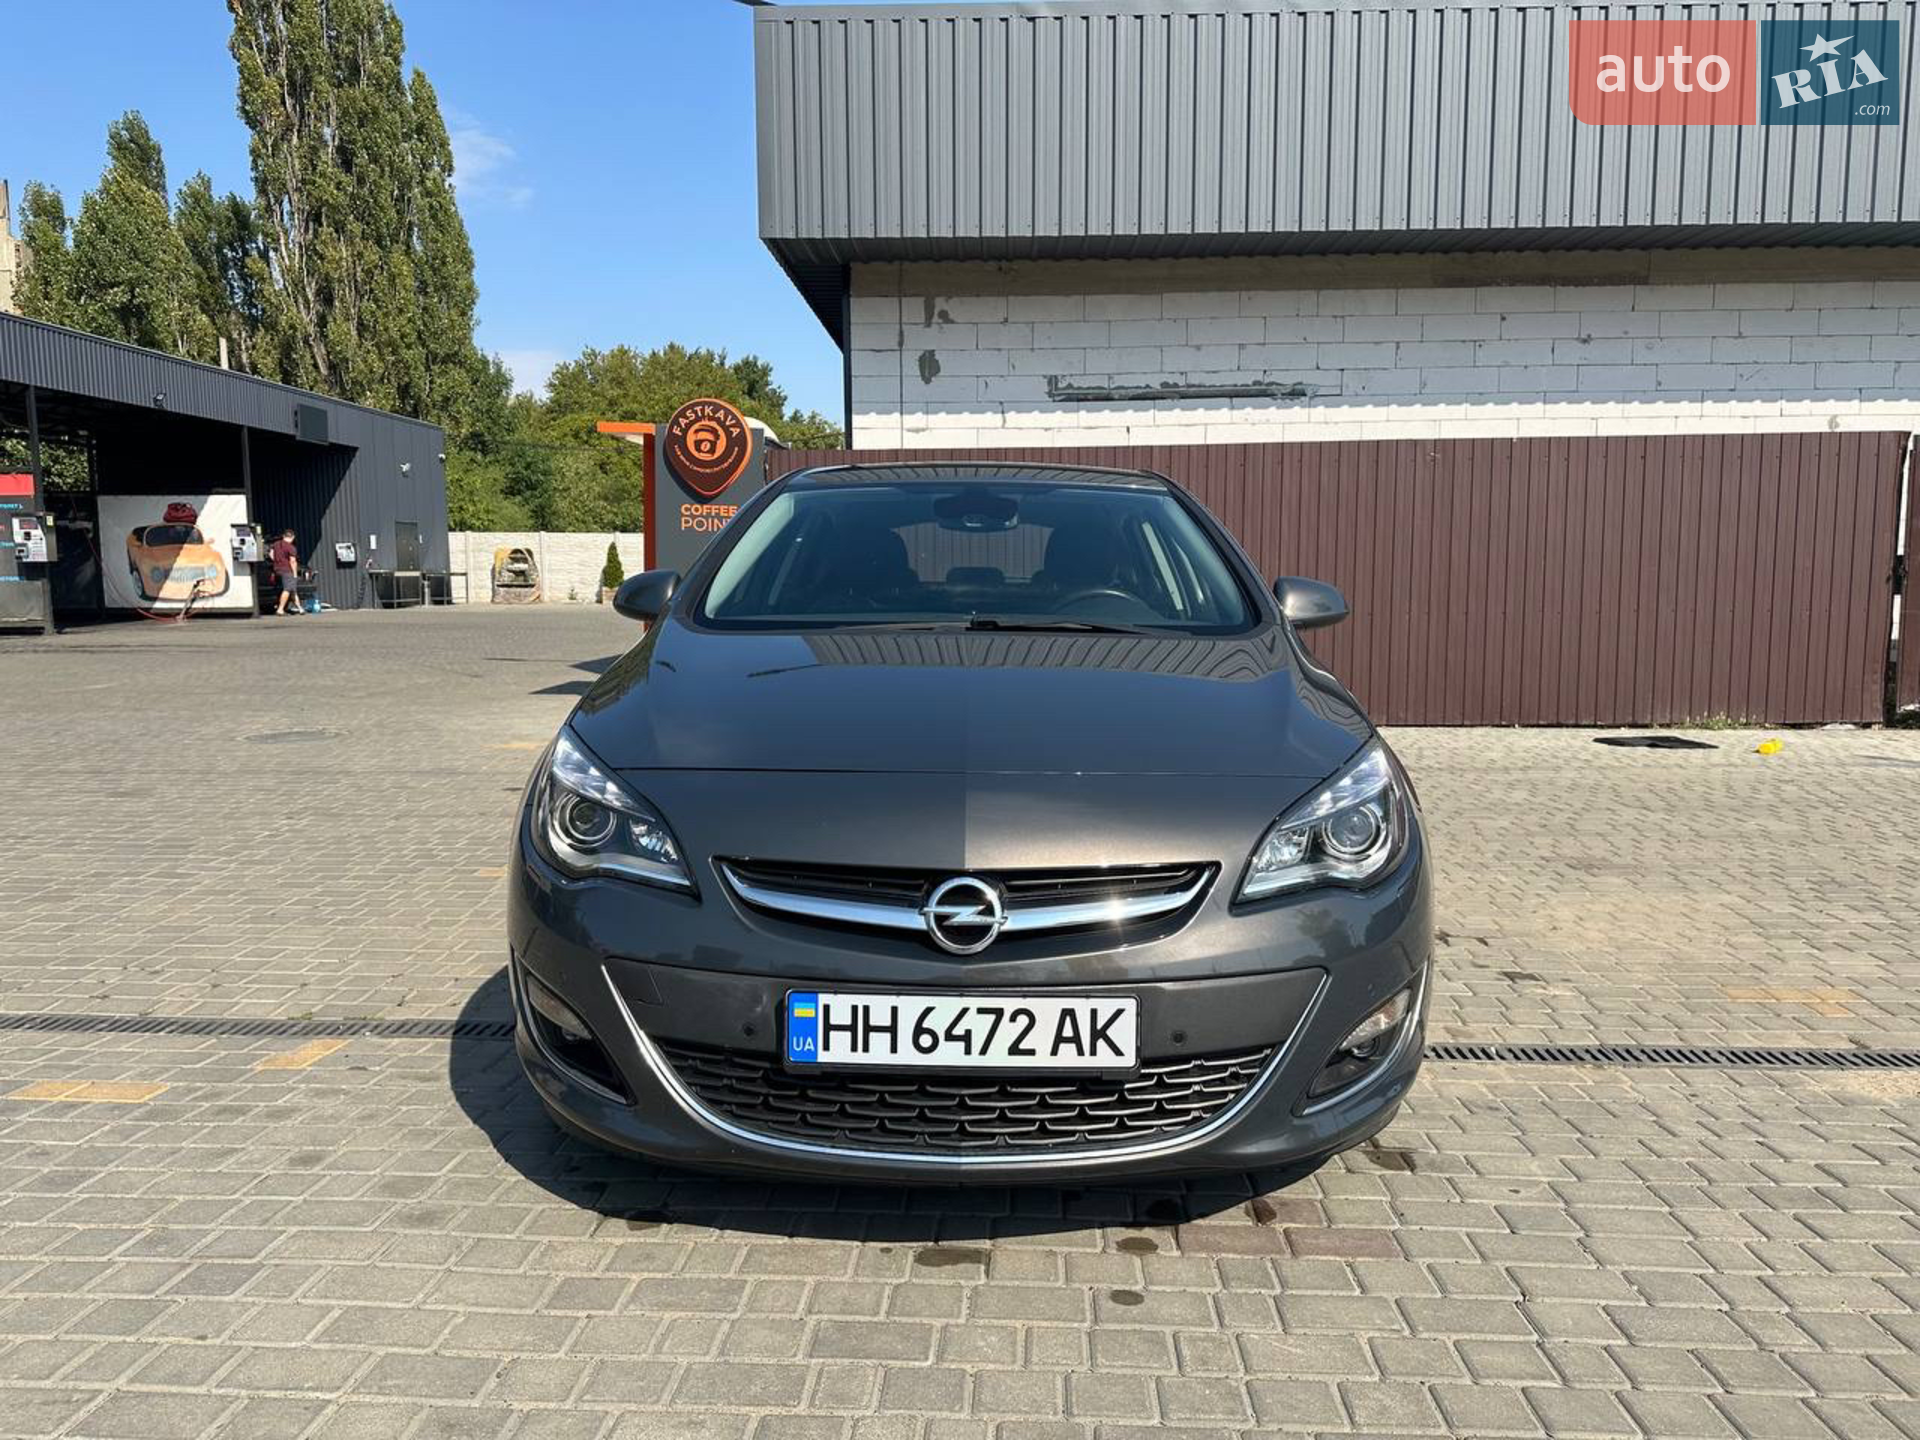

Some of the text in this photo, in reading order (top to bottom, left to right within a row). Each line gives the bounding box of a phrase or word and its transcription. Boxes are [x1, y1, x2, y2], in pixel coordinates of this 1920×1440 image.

[672, 405, 742, 438] FASTKAVA
[681, 504, 738, 517] COFFEE
[822, 1003, 1126, 1057] HH 6472 AK
[793, 1037, 815, 1052] UA
